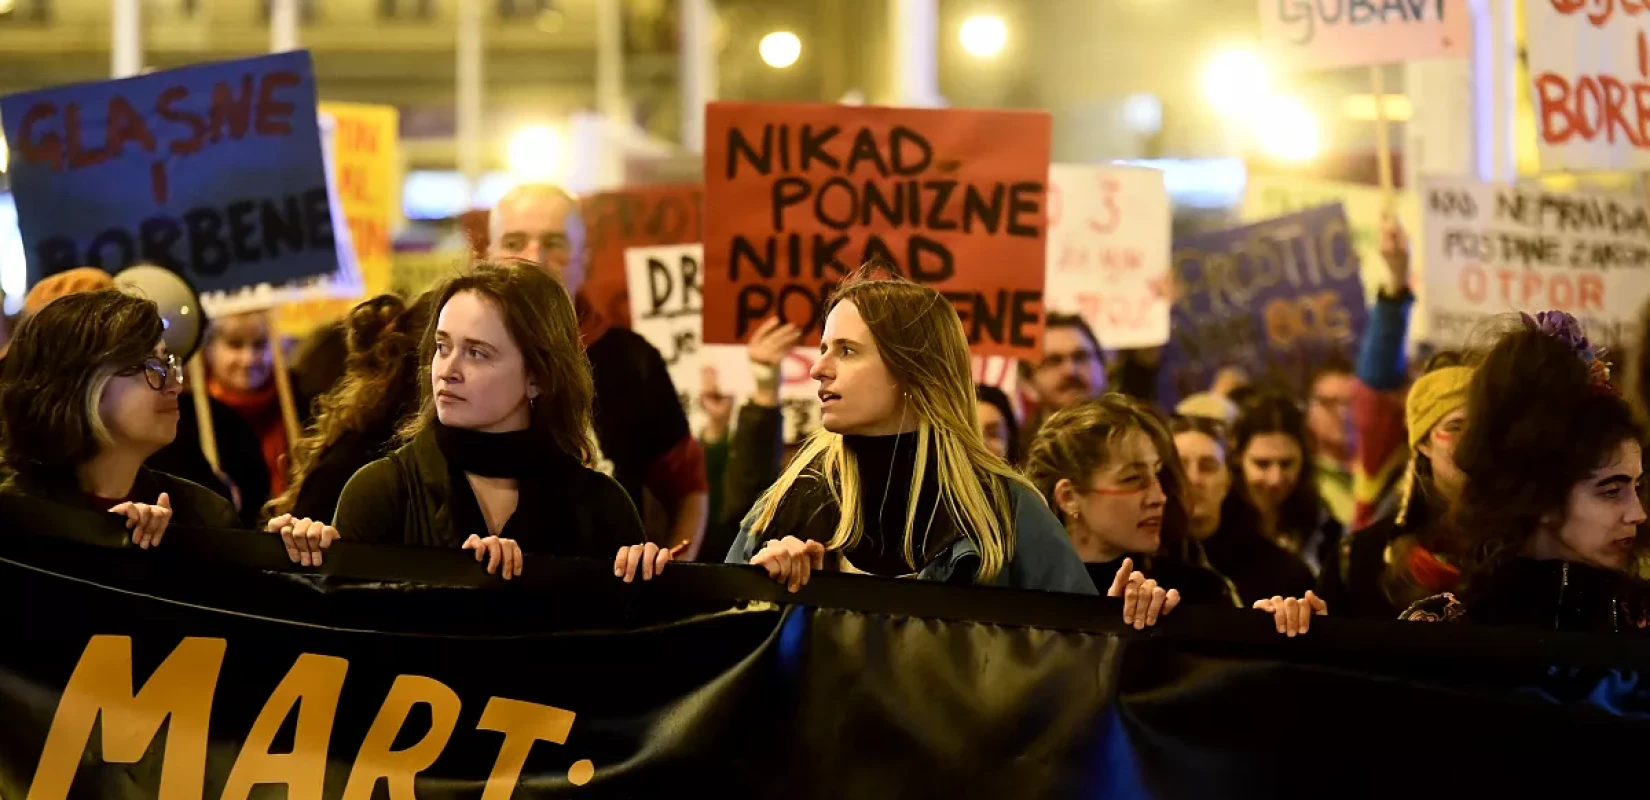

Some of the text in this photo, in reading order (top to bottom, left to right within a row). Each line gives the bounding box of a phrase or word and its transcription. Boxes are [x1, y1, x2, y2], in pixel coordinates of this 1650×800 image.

[17, 71, 300, 173] GLASNE
[726, 122, 933, 181] NIKAD
[150, 160, 168, 206] I
[771, 176, 1044, 238] PONIZNE
[38, 186, 337, 278] BORBENE
[729, 234, 955, 283] NIKAD
[736, 283, 1043, 347] POENE
[1458, 263, 1606, 310] OTPOR
